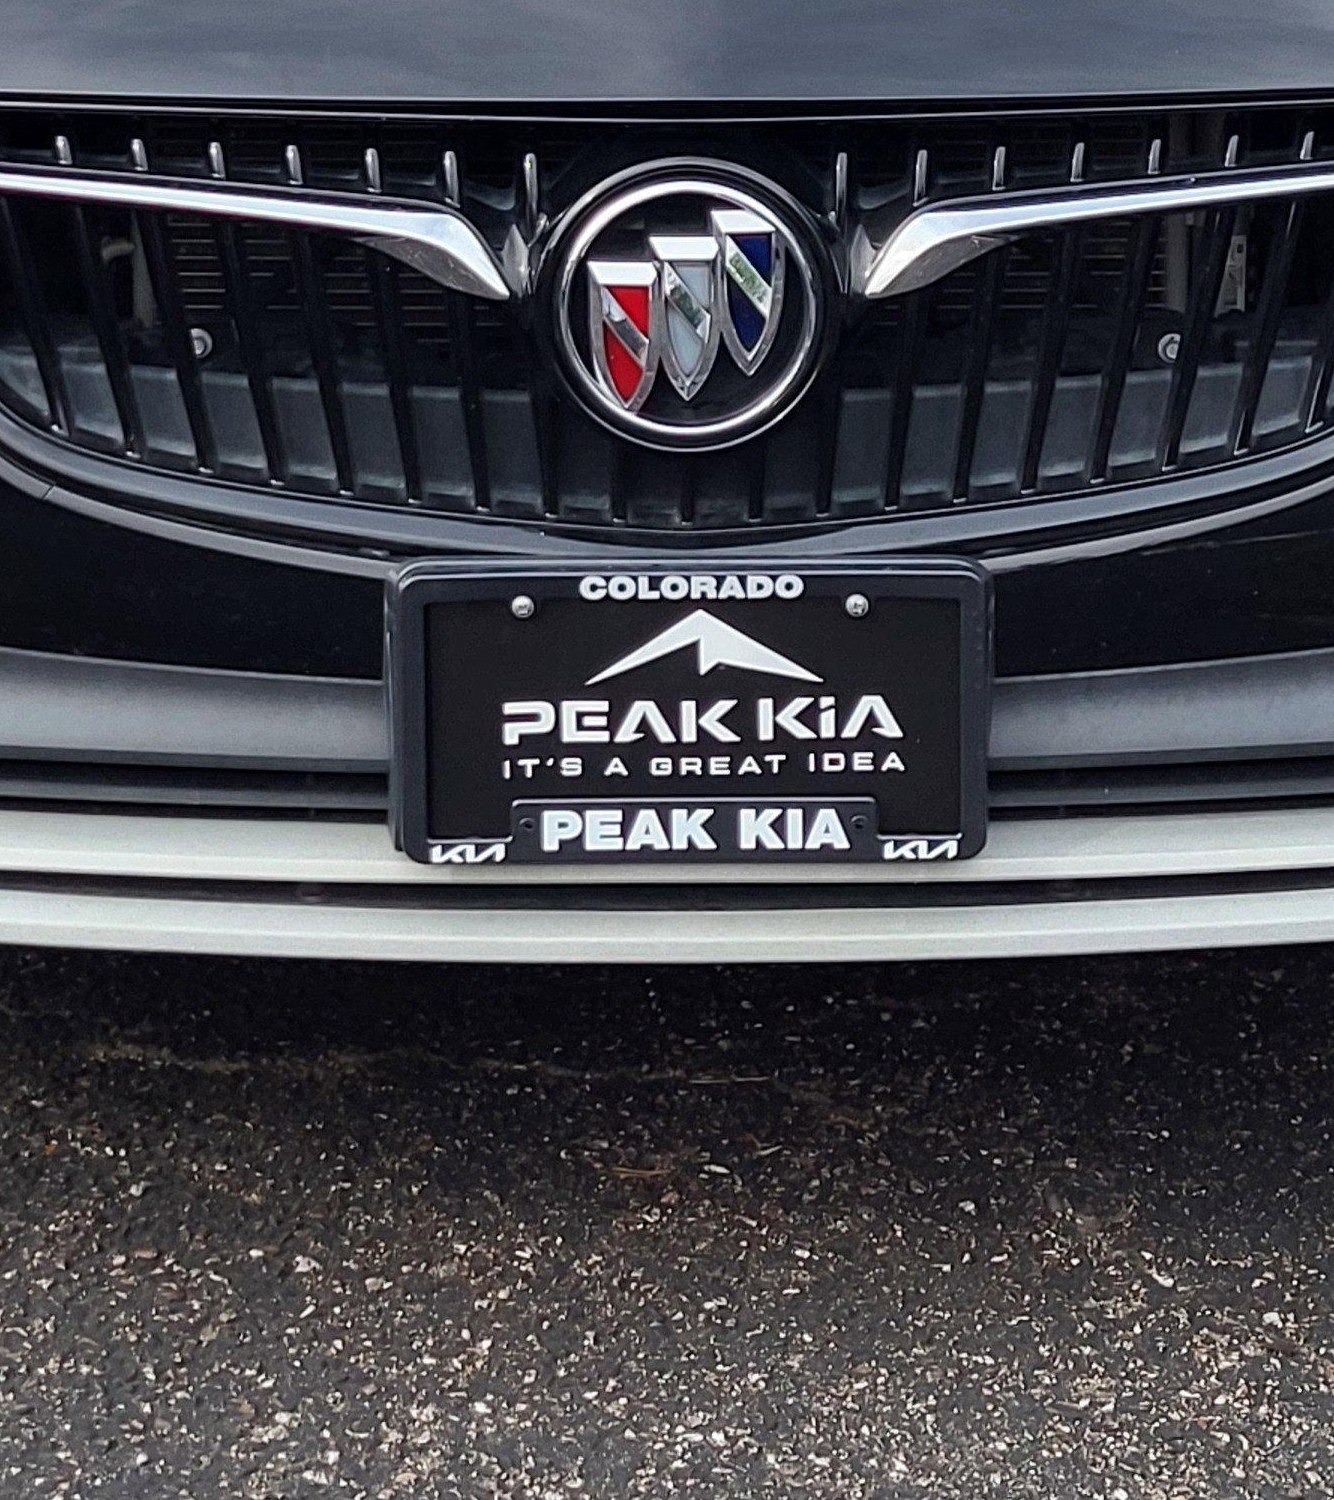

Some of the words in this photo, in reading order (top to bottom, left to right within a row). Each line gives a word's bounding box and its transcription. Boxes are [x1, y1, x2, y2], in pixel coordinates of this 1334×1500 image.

[579, 574, 805, 600] COLORADO
[502, 699, 742, 746] PEAK
[503, 756, 583, 779] IT'S
[604, 757, 629, 776] A
[649, 754, 787, 777] GREAT
[808, 751, 906, 773] IDEA
[540, 808, 717, 852] PEAK
[738, 807, 851, 851] KIA
[429, 842, 506, 864] KIA
[882, 838, 961, 861] KIA
